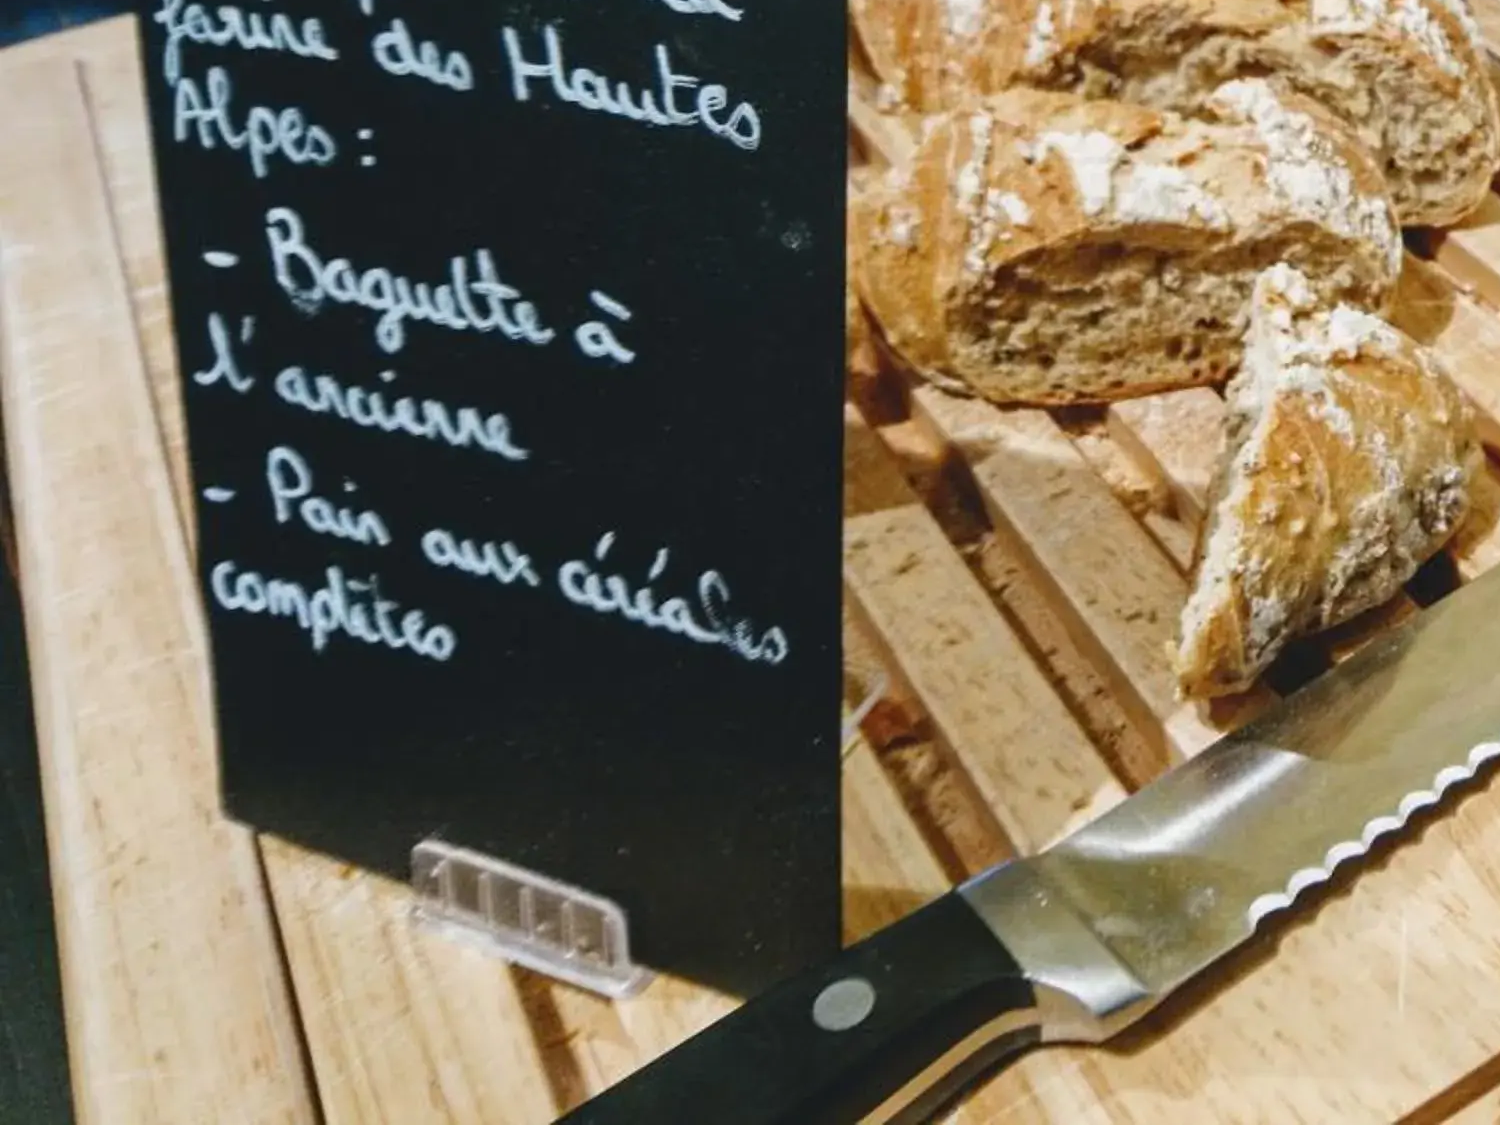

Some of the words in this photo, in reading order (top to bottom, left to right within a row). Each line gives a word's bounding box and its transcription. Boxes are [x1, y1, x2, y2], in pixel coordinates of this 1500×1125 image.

[372, 18, 473, 91] des
[502, 24, 761, 150] Hautes
[265, 206, 556, 353] Baguette
[574, 290, 636, 364] à
[211, 560, 456, 662] complètes
[266, 446, 391, 546] Pain
[421, 529, 540, 587] aux
[558, 531, 788, 663] céréales
